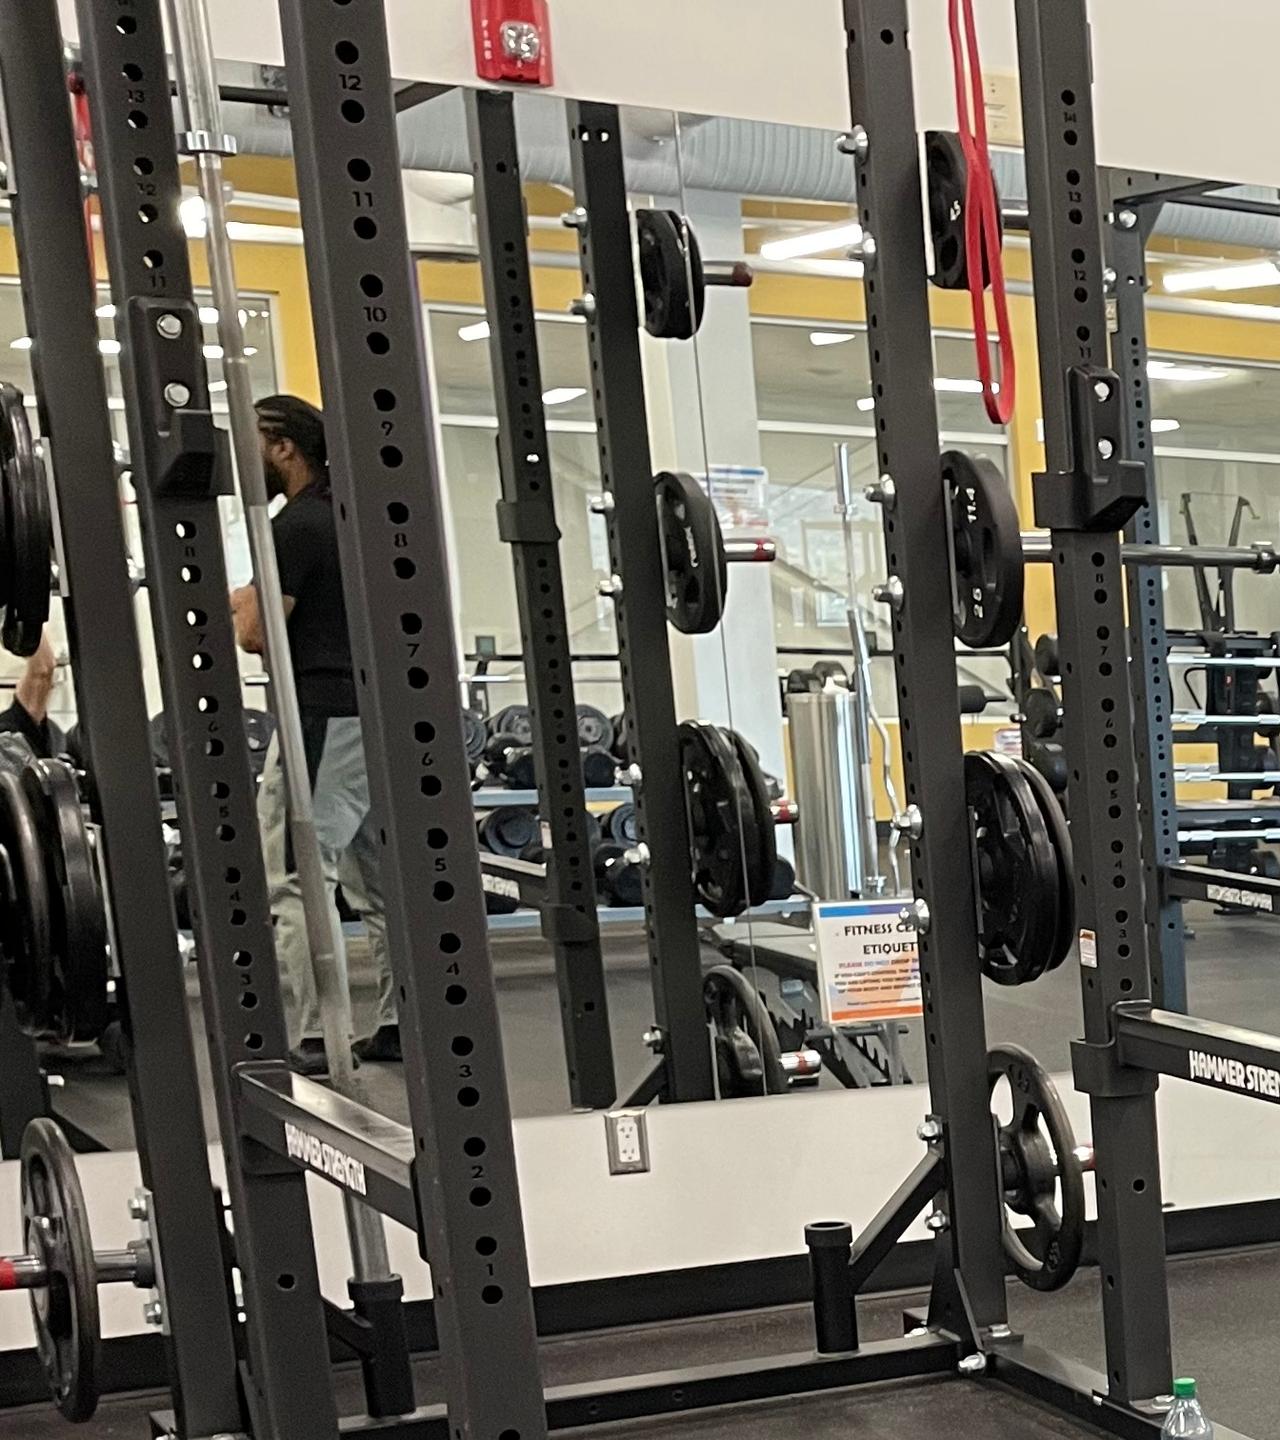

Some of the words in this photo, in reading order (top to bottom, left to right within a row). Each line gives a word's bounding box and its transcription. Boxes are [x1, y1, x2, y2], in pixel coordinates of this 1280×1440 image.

[338, 73, 362, 91] 12
[352, 191, 373, 208] 11
[363, 306, 387, 323] 10
[381, 420, 394, 436] 9
[394, 533, 408, 548] 8
[406, 643, 420, 658] 7
[421, 751, 434, 767] 6
[434, 857, 447, 872] 5
[844, 923, 893, 936] FITNESS
[863, 941, 919, 955] ETIQUET
[445, 961, 460, 976] 4
[459, 1064, 473, 1078] 3
[1189, 1049, 1247, 1089] HAMMER
[471, 1165, 484, 1179] 2
[486, 1263, 494, 1276] 1
